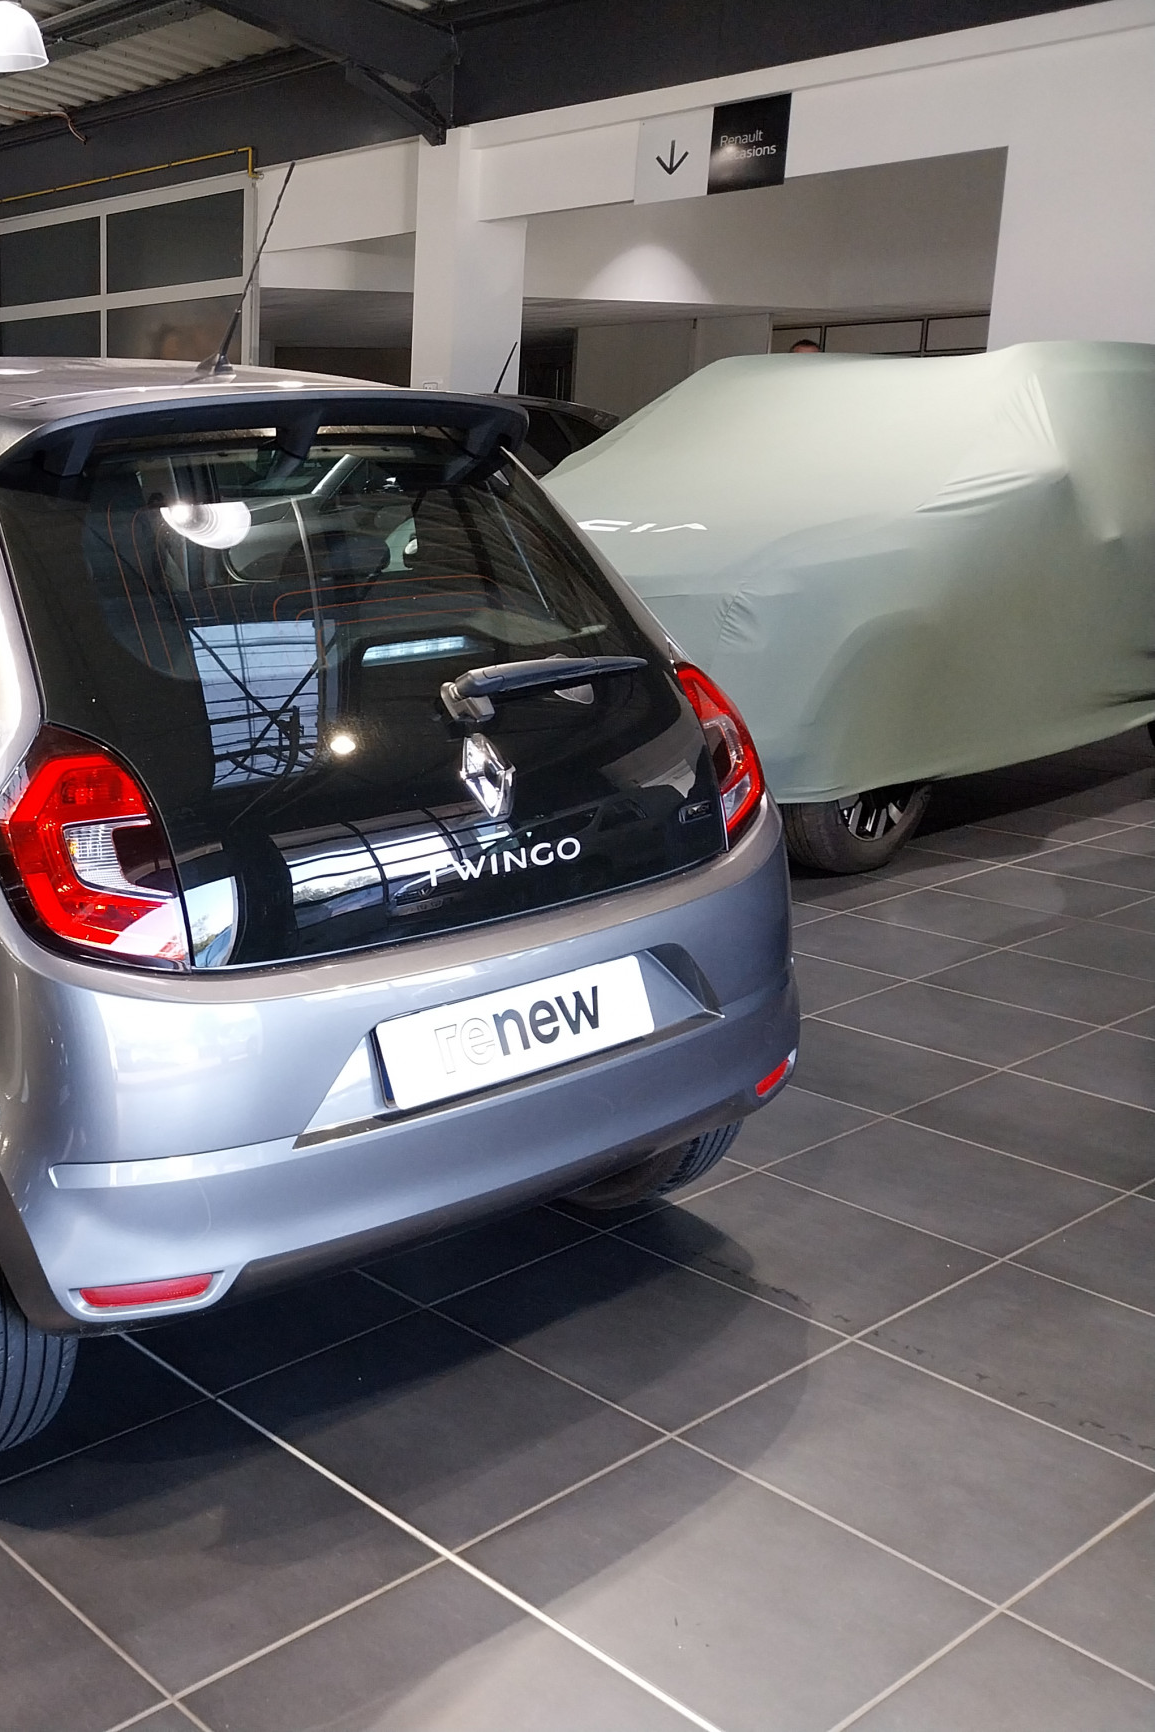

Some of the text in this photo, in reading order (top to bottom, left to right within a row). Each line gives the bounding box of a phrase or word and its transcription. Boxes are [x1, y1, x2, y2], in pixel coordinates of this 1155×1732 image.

[719, 129, 764, 147] Renault
[719, 144, 777, 161] casions
[576, 518, 708, 533] CIA
[425, 836, 581, 887] TWINGO
[434, 985, 600, 1075] renew
